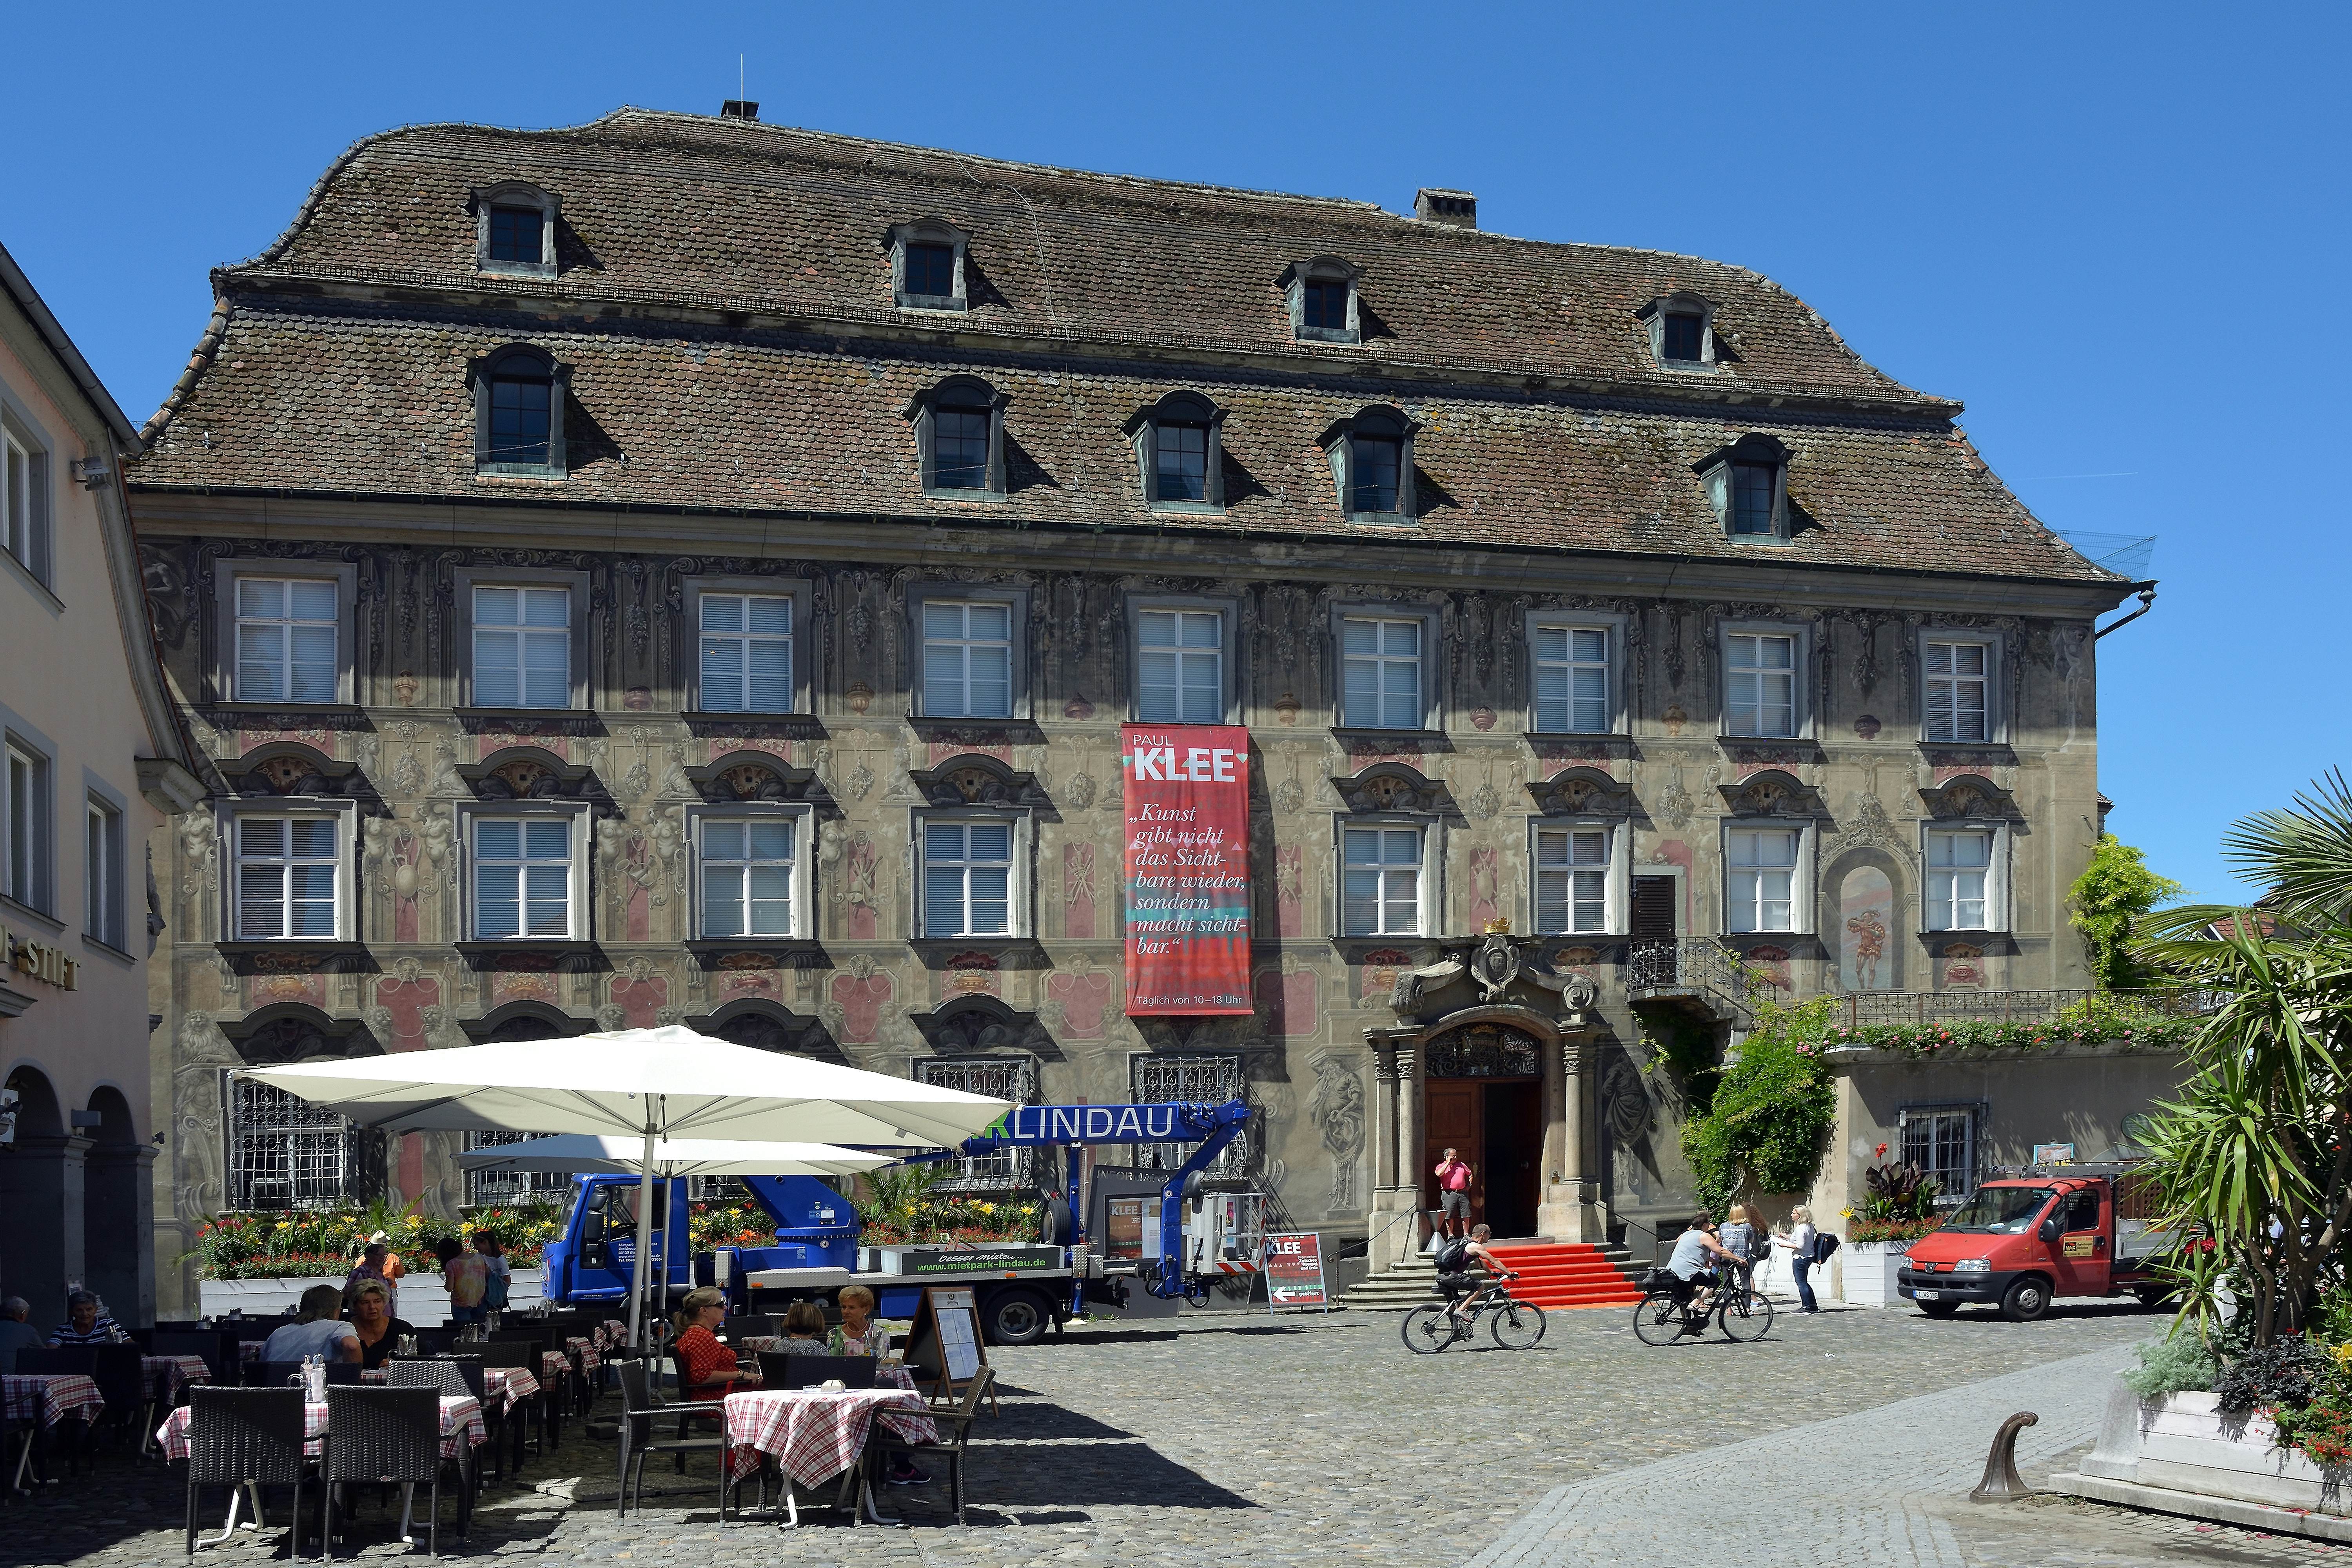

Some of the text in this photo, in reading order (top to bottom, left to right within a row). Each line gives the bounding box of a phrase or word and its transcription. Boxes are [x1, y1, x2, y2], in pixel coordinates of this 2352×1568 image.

[1133, 734, 1174, 746] PAUL
[1134, 747, 1236, 782] KLEE
[1128, 803, 1196, 824] „Kunst
[1134, 826, 1224, 849] gibt nicht
[1135, 848, 1227, 866] das Sicht-
[1136, 871, 1245, 891] bare wieder,
[1135, 893, 1210, 910] sondern
[1136, 915, 1247, 932] macht sicht-
[1136, 937, 1181, 955] bar.“
[1137, 996, 1170, 1007] Täglich
[1225, 995, 1242, 1004] Uhr
[1111, 1205, 1138, 1215] KLEE
[1266, 1241, 1301, 1255] KLEE
[917, 1258, 1046, 1271] www.mietpark-lindau.de
[938, 1254, 973, 1262] besser
